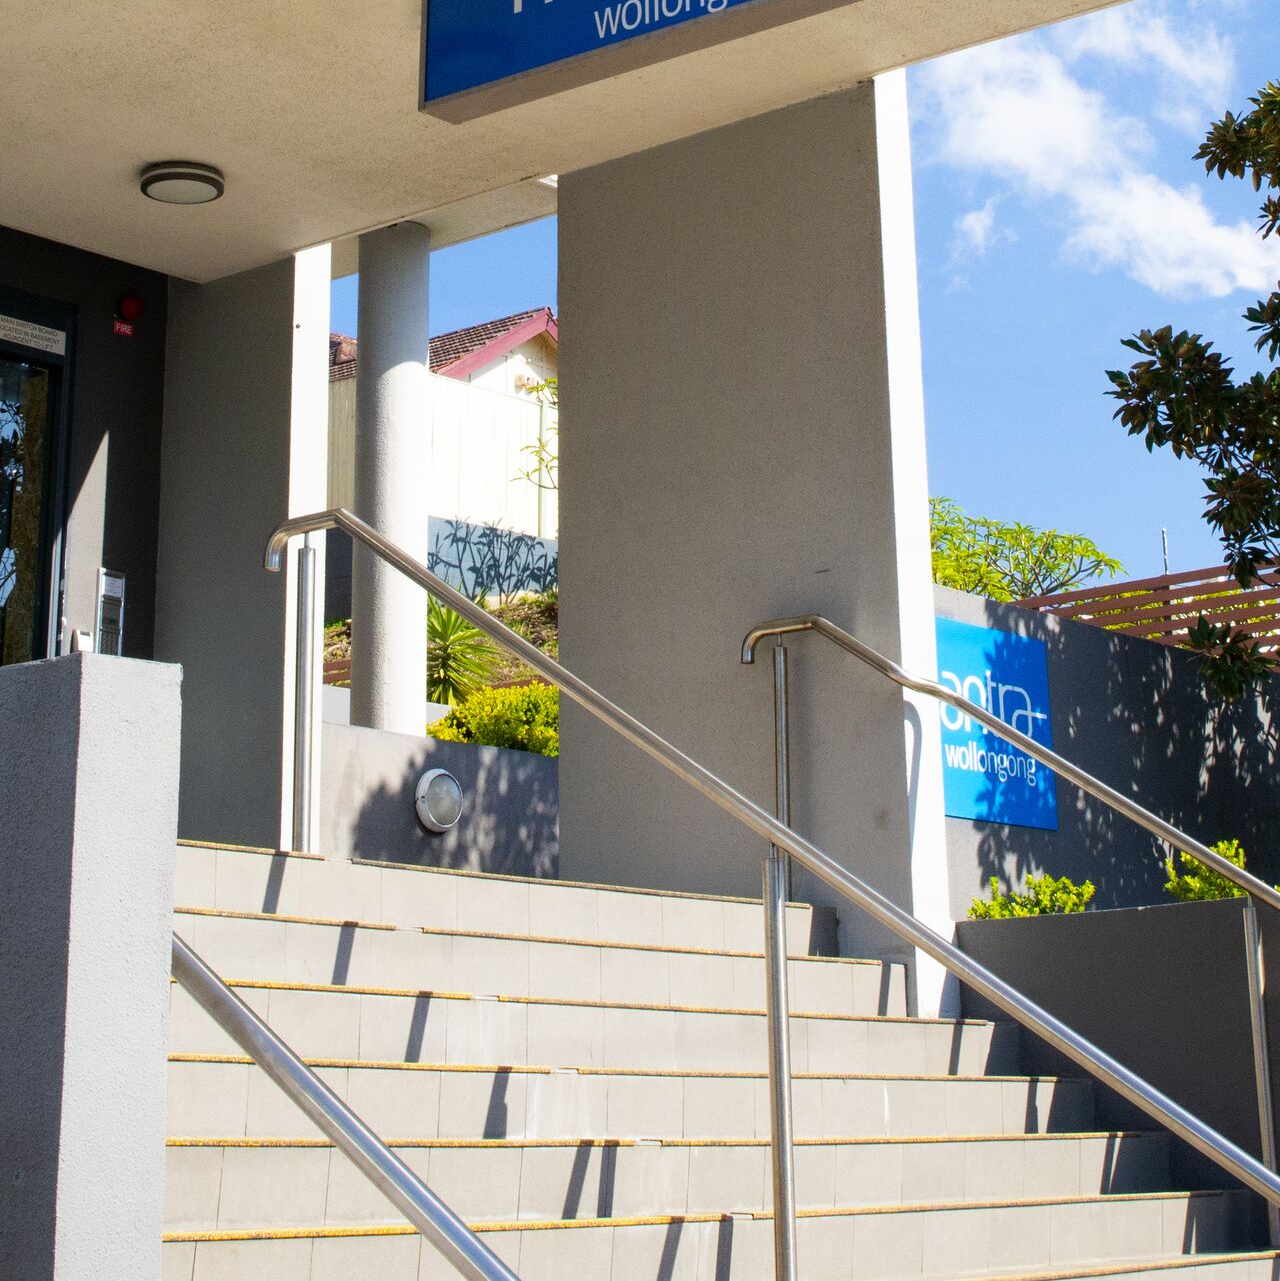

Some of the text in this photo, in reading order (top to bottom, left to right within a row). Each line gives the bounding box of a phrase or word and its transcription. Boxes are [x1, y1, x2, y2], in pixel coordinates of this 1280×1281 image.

[0, 316, 58, 337] MAIN SWITCH BOARD
[116, 322, 133, 335] FIRE
[3, 333, 32, 345] ADJACENT
[33, 340, 41, 348] TO
[30, 332, 60, 345] BASEMENT
[940, 670, 1048, 738] antra
[944, 741, 1037, 786] wollongong
